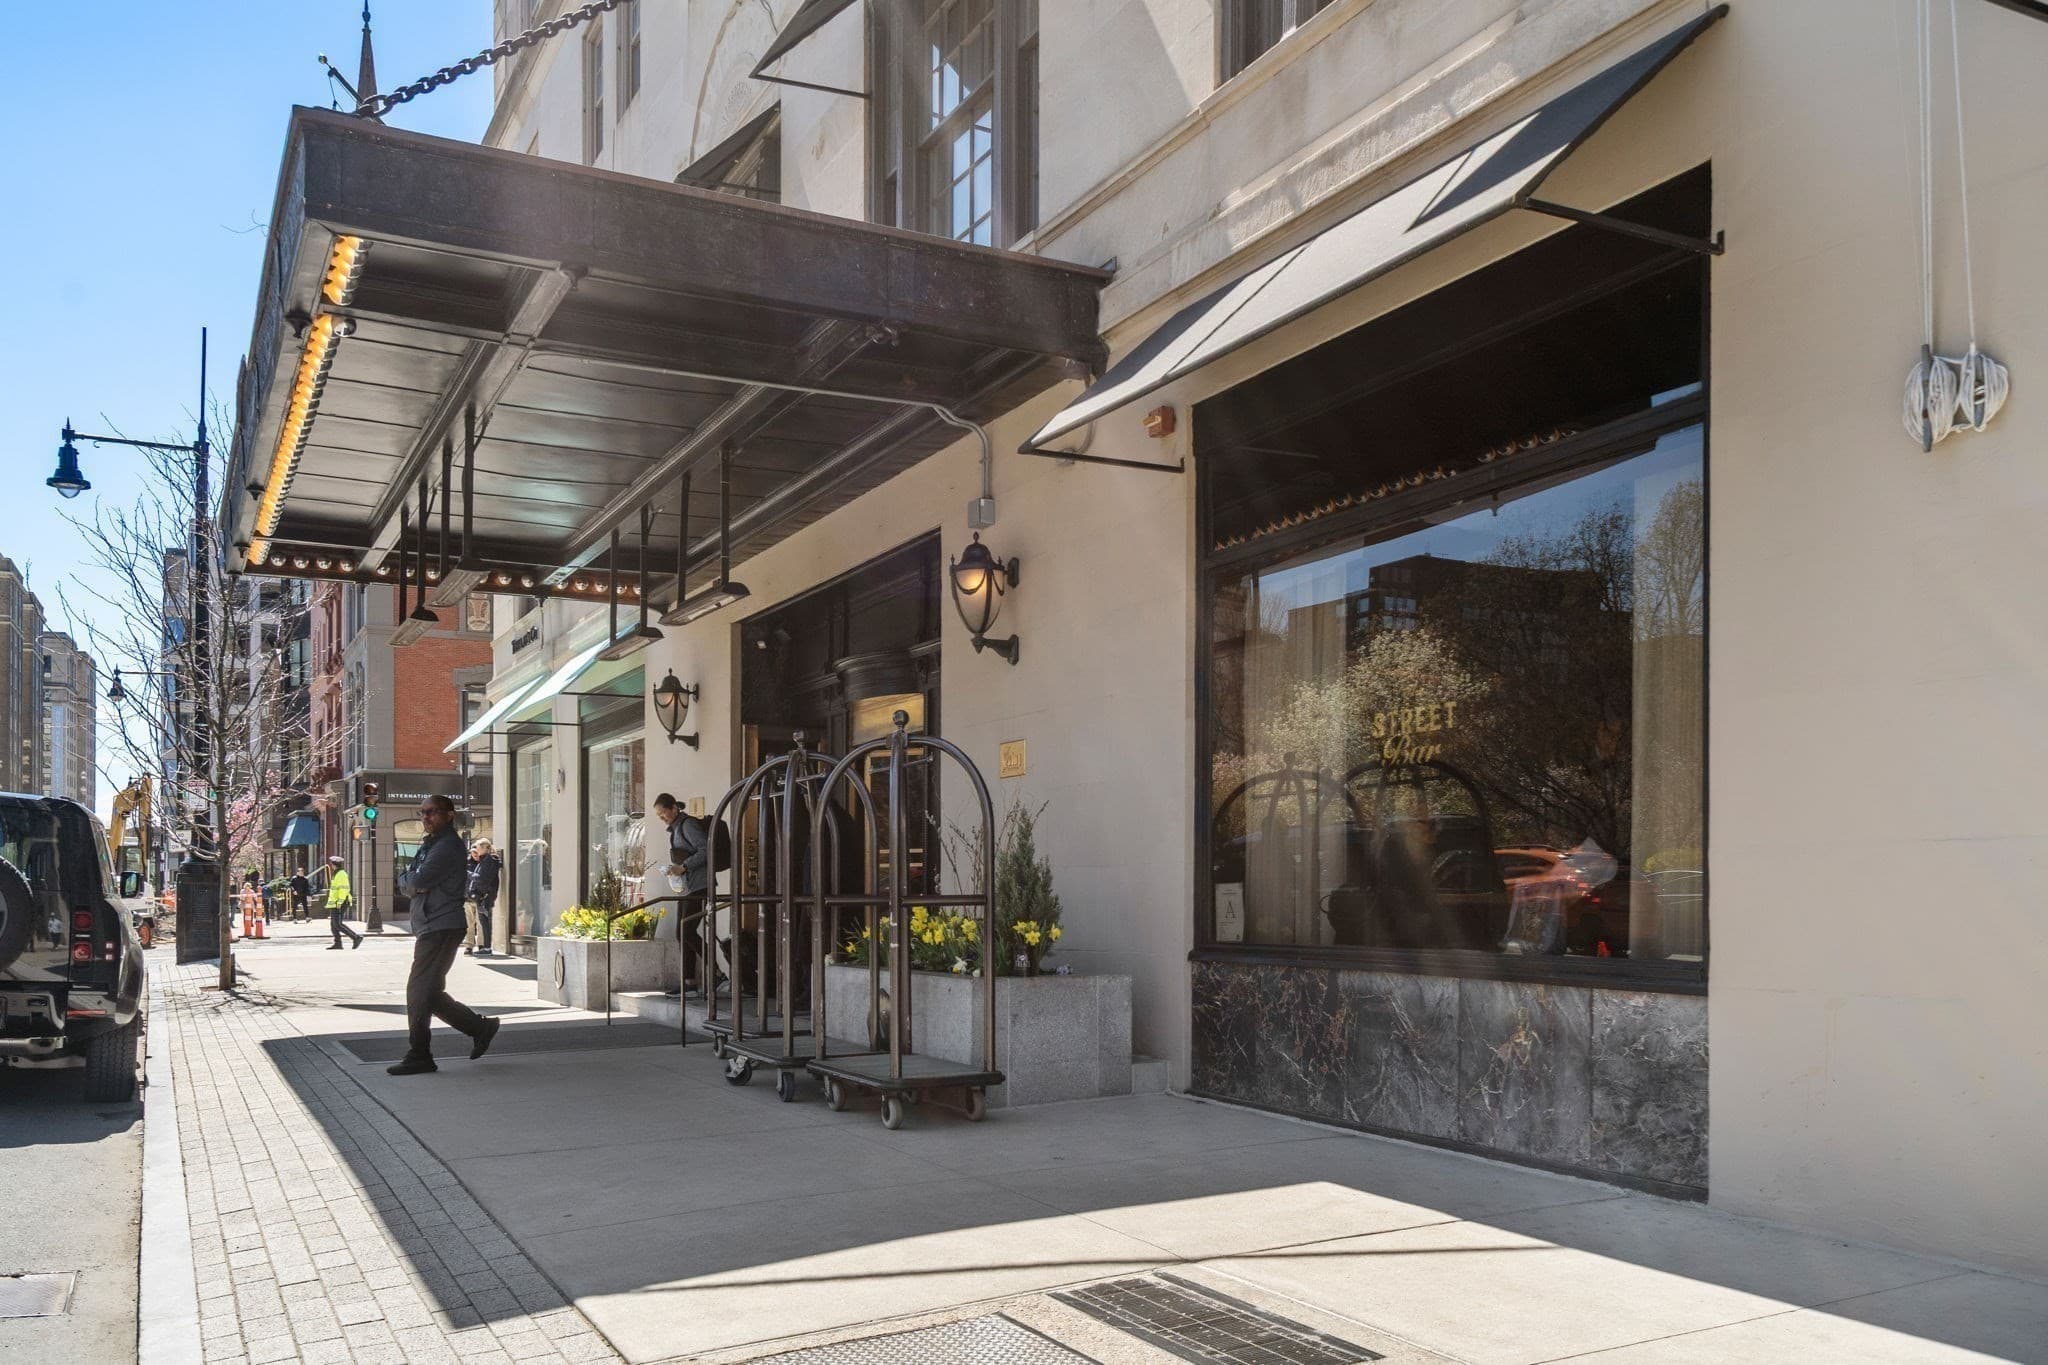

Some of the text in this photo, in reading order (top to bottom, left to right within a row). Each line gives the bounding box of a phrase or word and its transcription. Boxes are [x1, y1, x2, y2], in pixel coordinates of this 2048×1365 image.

[1372, 701, 1457, 738] STREET
[1381, 735, 1441, 765] Bar
[1224, 901, 1236, 918] A
